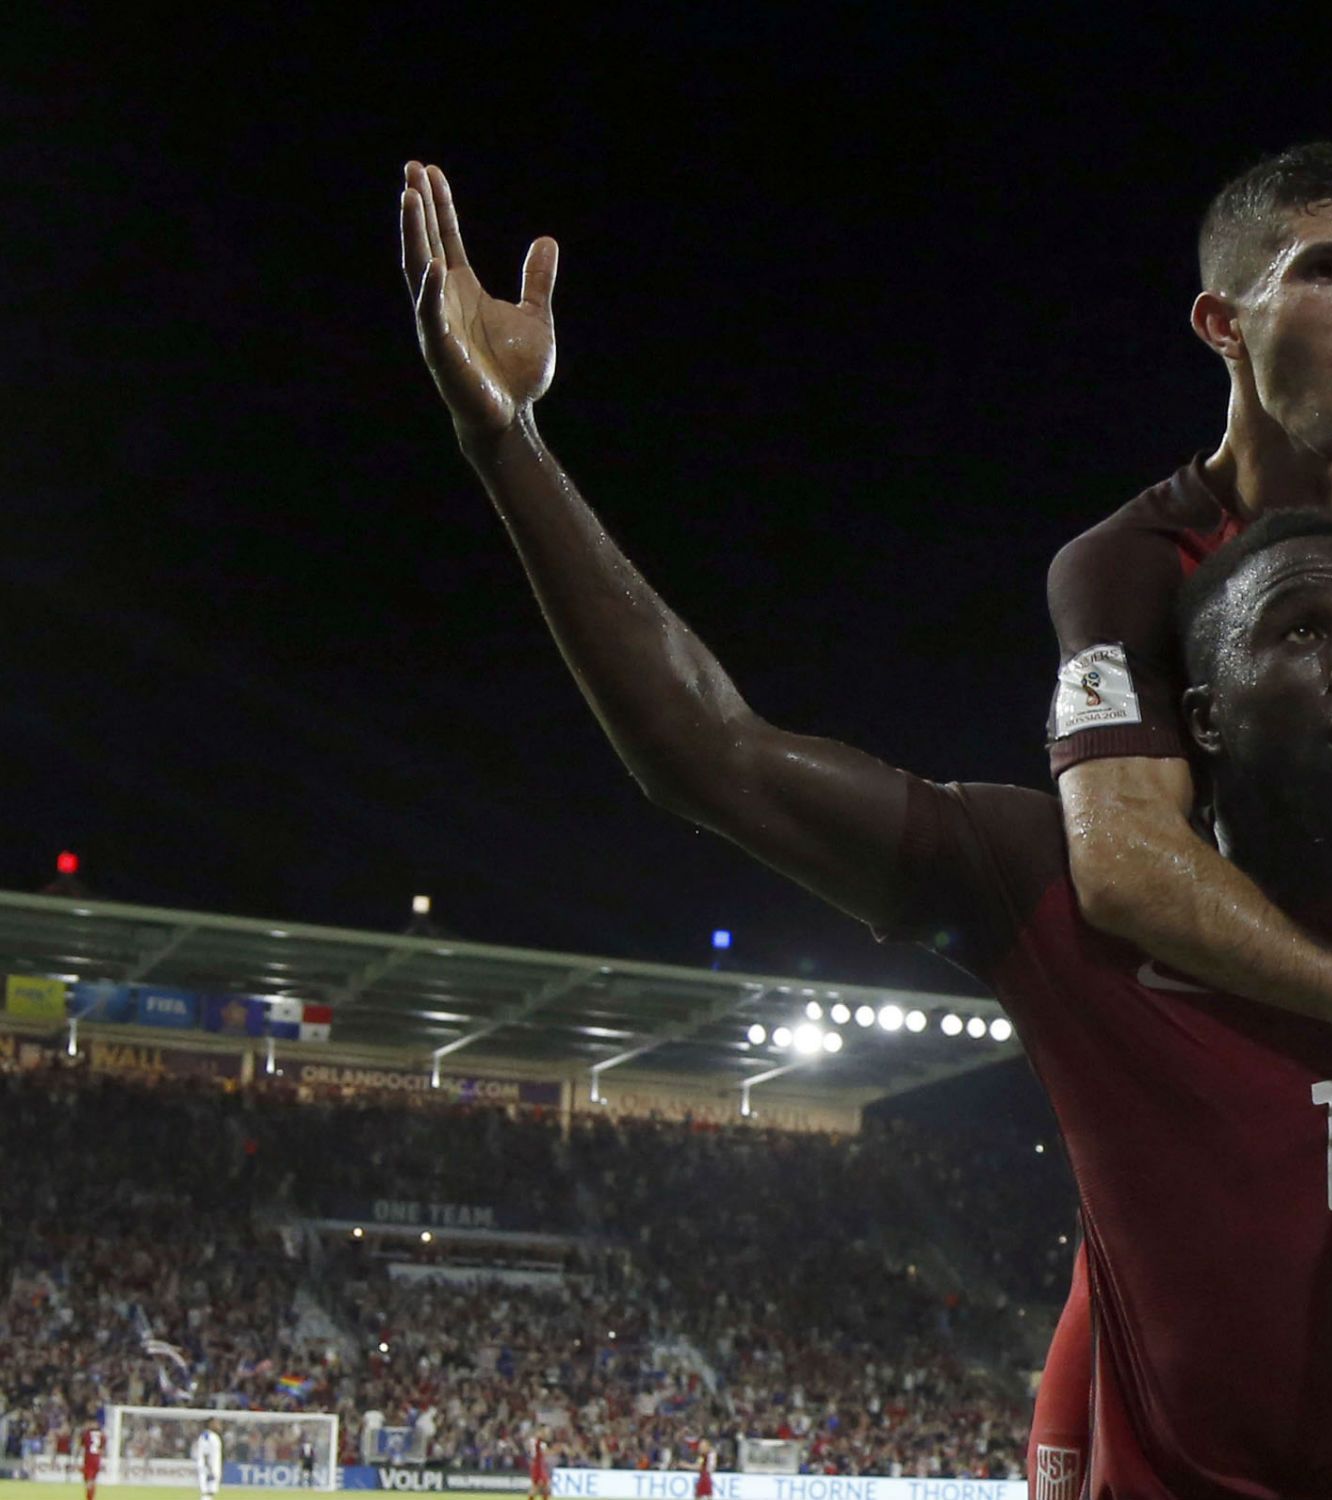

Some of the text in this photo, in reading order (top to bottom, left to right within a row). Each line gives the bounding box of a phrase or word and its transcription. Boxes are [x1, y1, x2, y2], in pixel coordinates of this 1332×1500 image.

[146, 996, 187, 1015] FIFA
[301, 1065, 520, 1099] ORLANDOCITSC.COM
[373, 1199, 421, 1224] ONE
[1039, 1448, 1078, 1480] USA
[379, 1469, 444, 1492] VOLPI
[633, 1473, 742, 1498] THONE
[774, 1478, 877, 1500] THORNE
